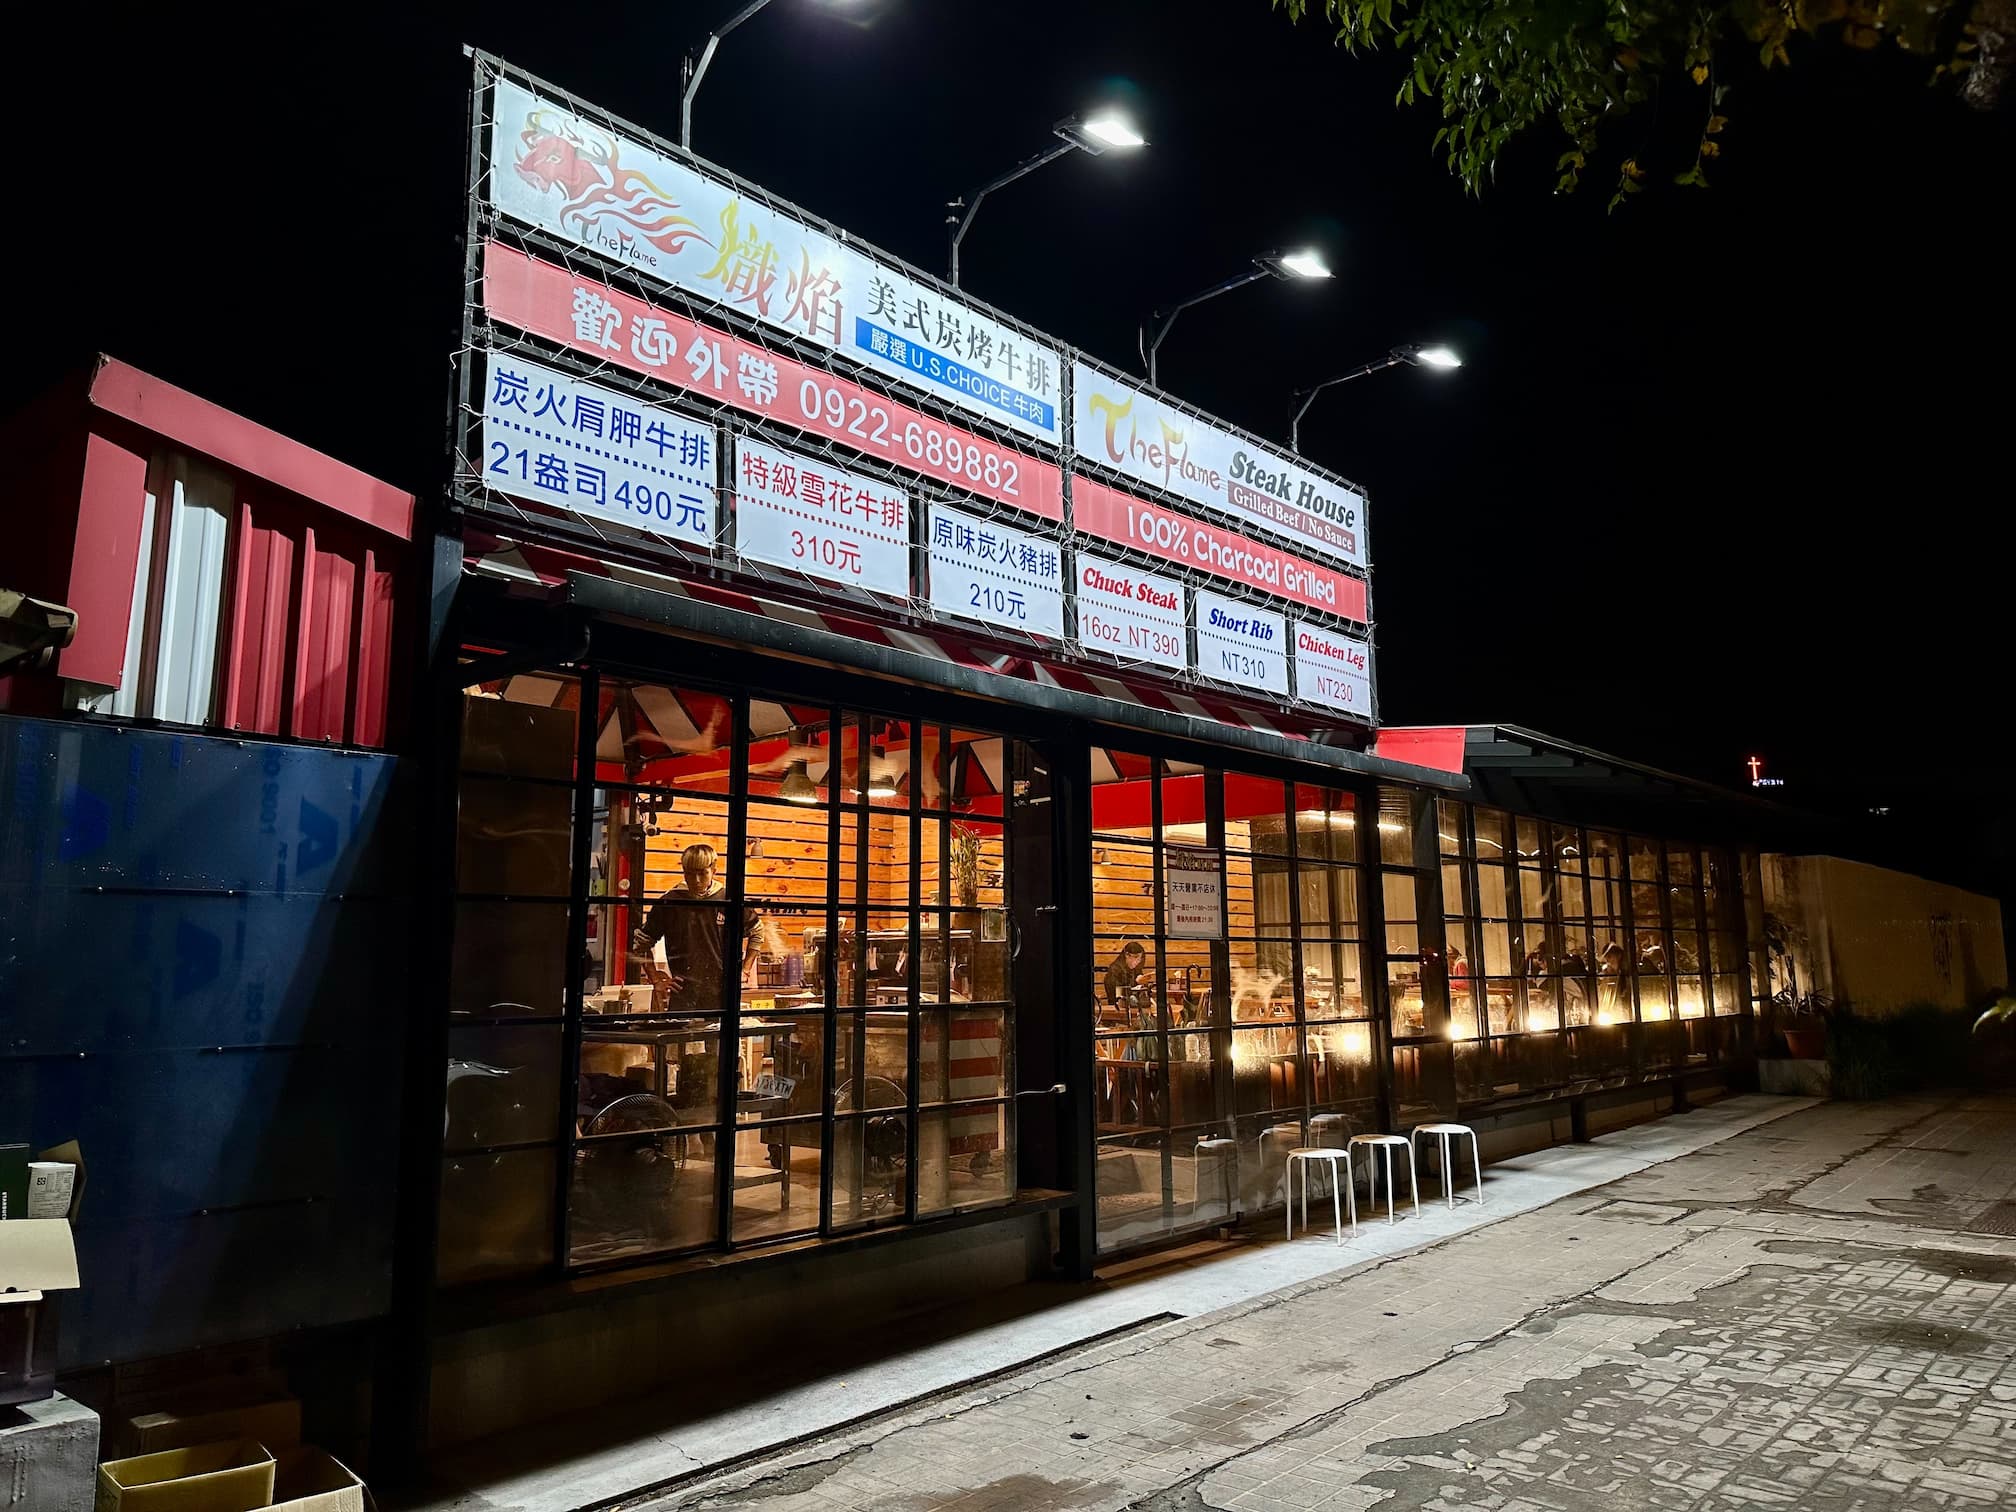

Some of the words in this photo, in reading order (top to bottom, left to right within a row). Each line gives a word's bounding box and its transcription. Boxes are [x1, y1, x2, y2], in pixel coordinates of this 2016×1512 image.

[696, 197, 844, 345] 熾焰
[868, 276, 1051, 396] 美式炭烤牛排
[492, 367, 710, 471] 炭火肩胛牛排
[571, 287, 779, 406] 歡迎外帶
[800, 379, 1020, 496] 0922-689882
[742, 452, 904, 530] 特級雪花牛排
[1229, 451, 1292, 501] Steak
[1296, 481, 1355, 528] House
[1234, 487, 1273, 515] Grilled
[1275, 504, 1299, 529] Beef
[1308, 517, 1323, 537] No
[1324, 528, 1353, 549] Sauce
[791, 530, 862, 575] 310元
[932, 515, 1058, 580] 原味炭火豬排
[1128, 506, 1188, 557] 100%
[1193, 532, 1280, 587] Charcoal
[1284, 564, 1336, 605] Grilled
[970, 583, 1026, 621] 210元
[1083, 567, 1132, 599] Chuck
[1136, 584, 1178, 611] Steak
[1082, 614, 1121, 643] 16oz
[1129, 625, 1179, 657] NT390
[1208, 607, 1247, 633] Short
[1249, 619, 1273, 641] Rib
[1298, 632, 1344, 660] Chicken
[1346, 649, 1365, 670] Leg
[1222, 650, 1265, 680] NT310
[1317, 676, 1353, 703] NT230
